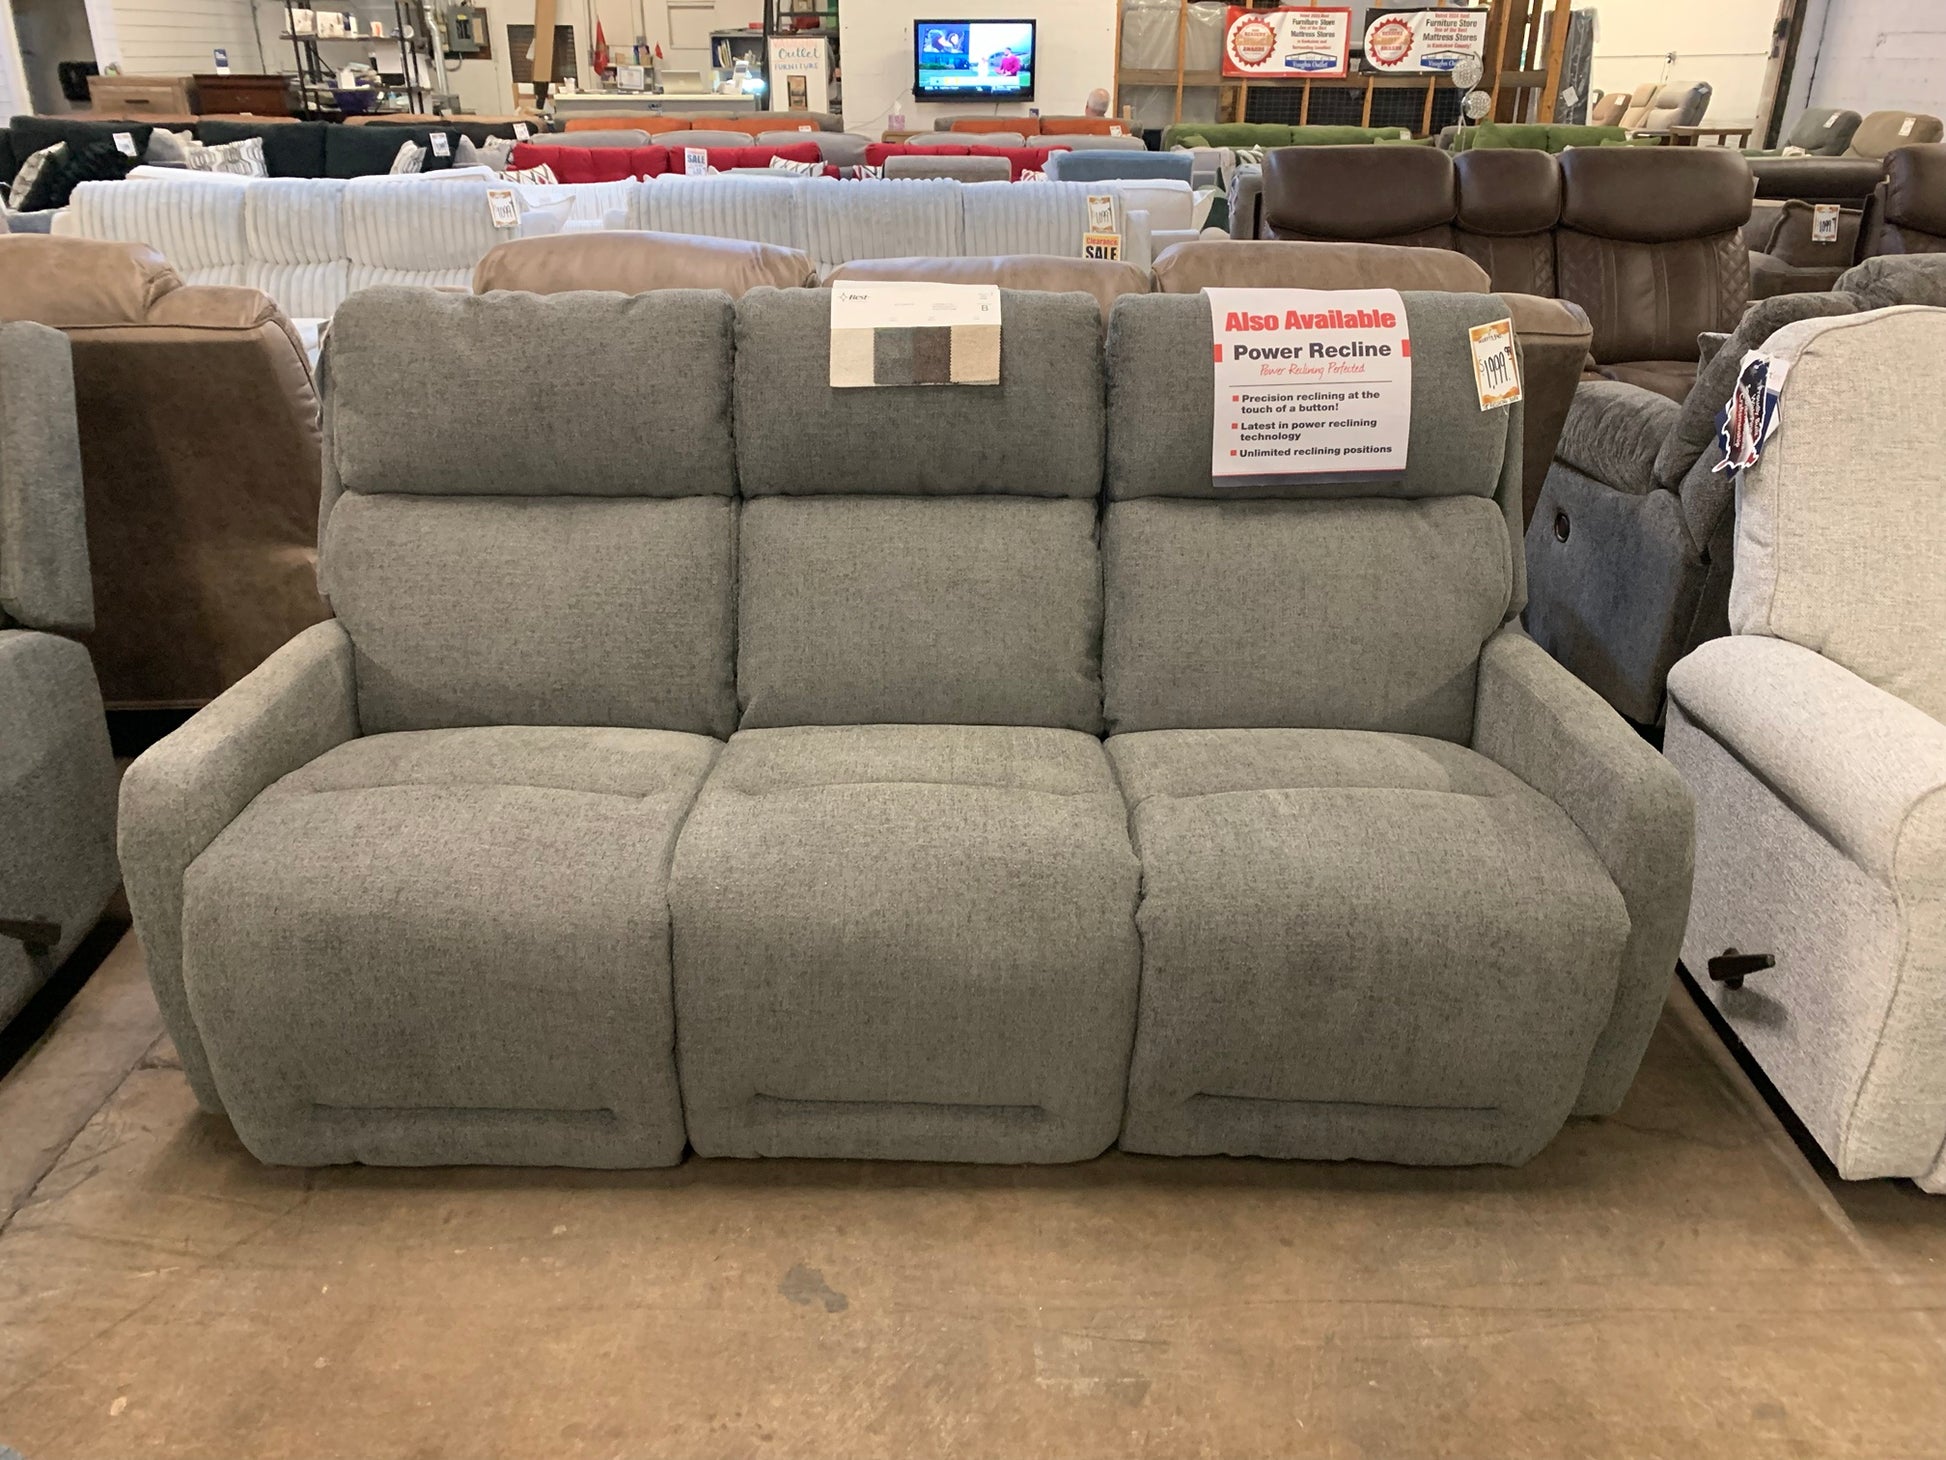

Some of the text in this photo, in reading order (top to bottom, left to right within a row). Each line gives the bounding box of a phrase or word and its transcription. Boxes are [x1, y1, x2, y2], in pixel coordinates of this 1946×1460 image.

[1423, 33, 1453, 41] Mattress
[778, 48, 820, 59] Outlet
[687, 154, 705, 164] SALE
[1086, 245, 1117, 260] SALE
[1225, 309, 1396, 332] Also Available
[1234, 342, 1391, 360] Power Recline
[1260, 361, 1366, 379] Power Reclining Perfected
[1242, 394, 1294, 403] Precision
[1297, 392, 1346, 402] reclining
[1362, 391, 1380, 399] the
[1241, 406, 1273, 414] touch
[1276, 405, 1286, 413] of
[1299, 403, 1339, 412] button!
[1241, 422, 1276, 430] Latest
[1291, 420, 1326, 431] power
[1329, 419, 1377, 429] reclining
[1240, 432, 1301, 441] technology
[1240, 445, 1392, 458] Unlimited reclining positions
